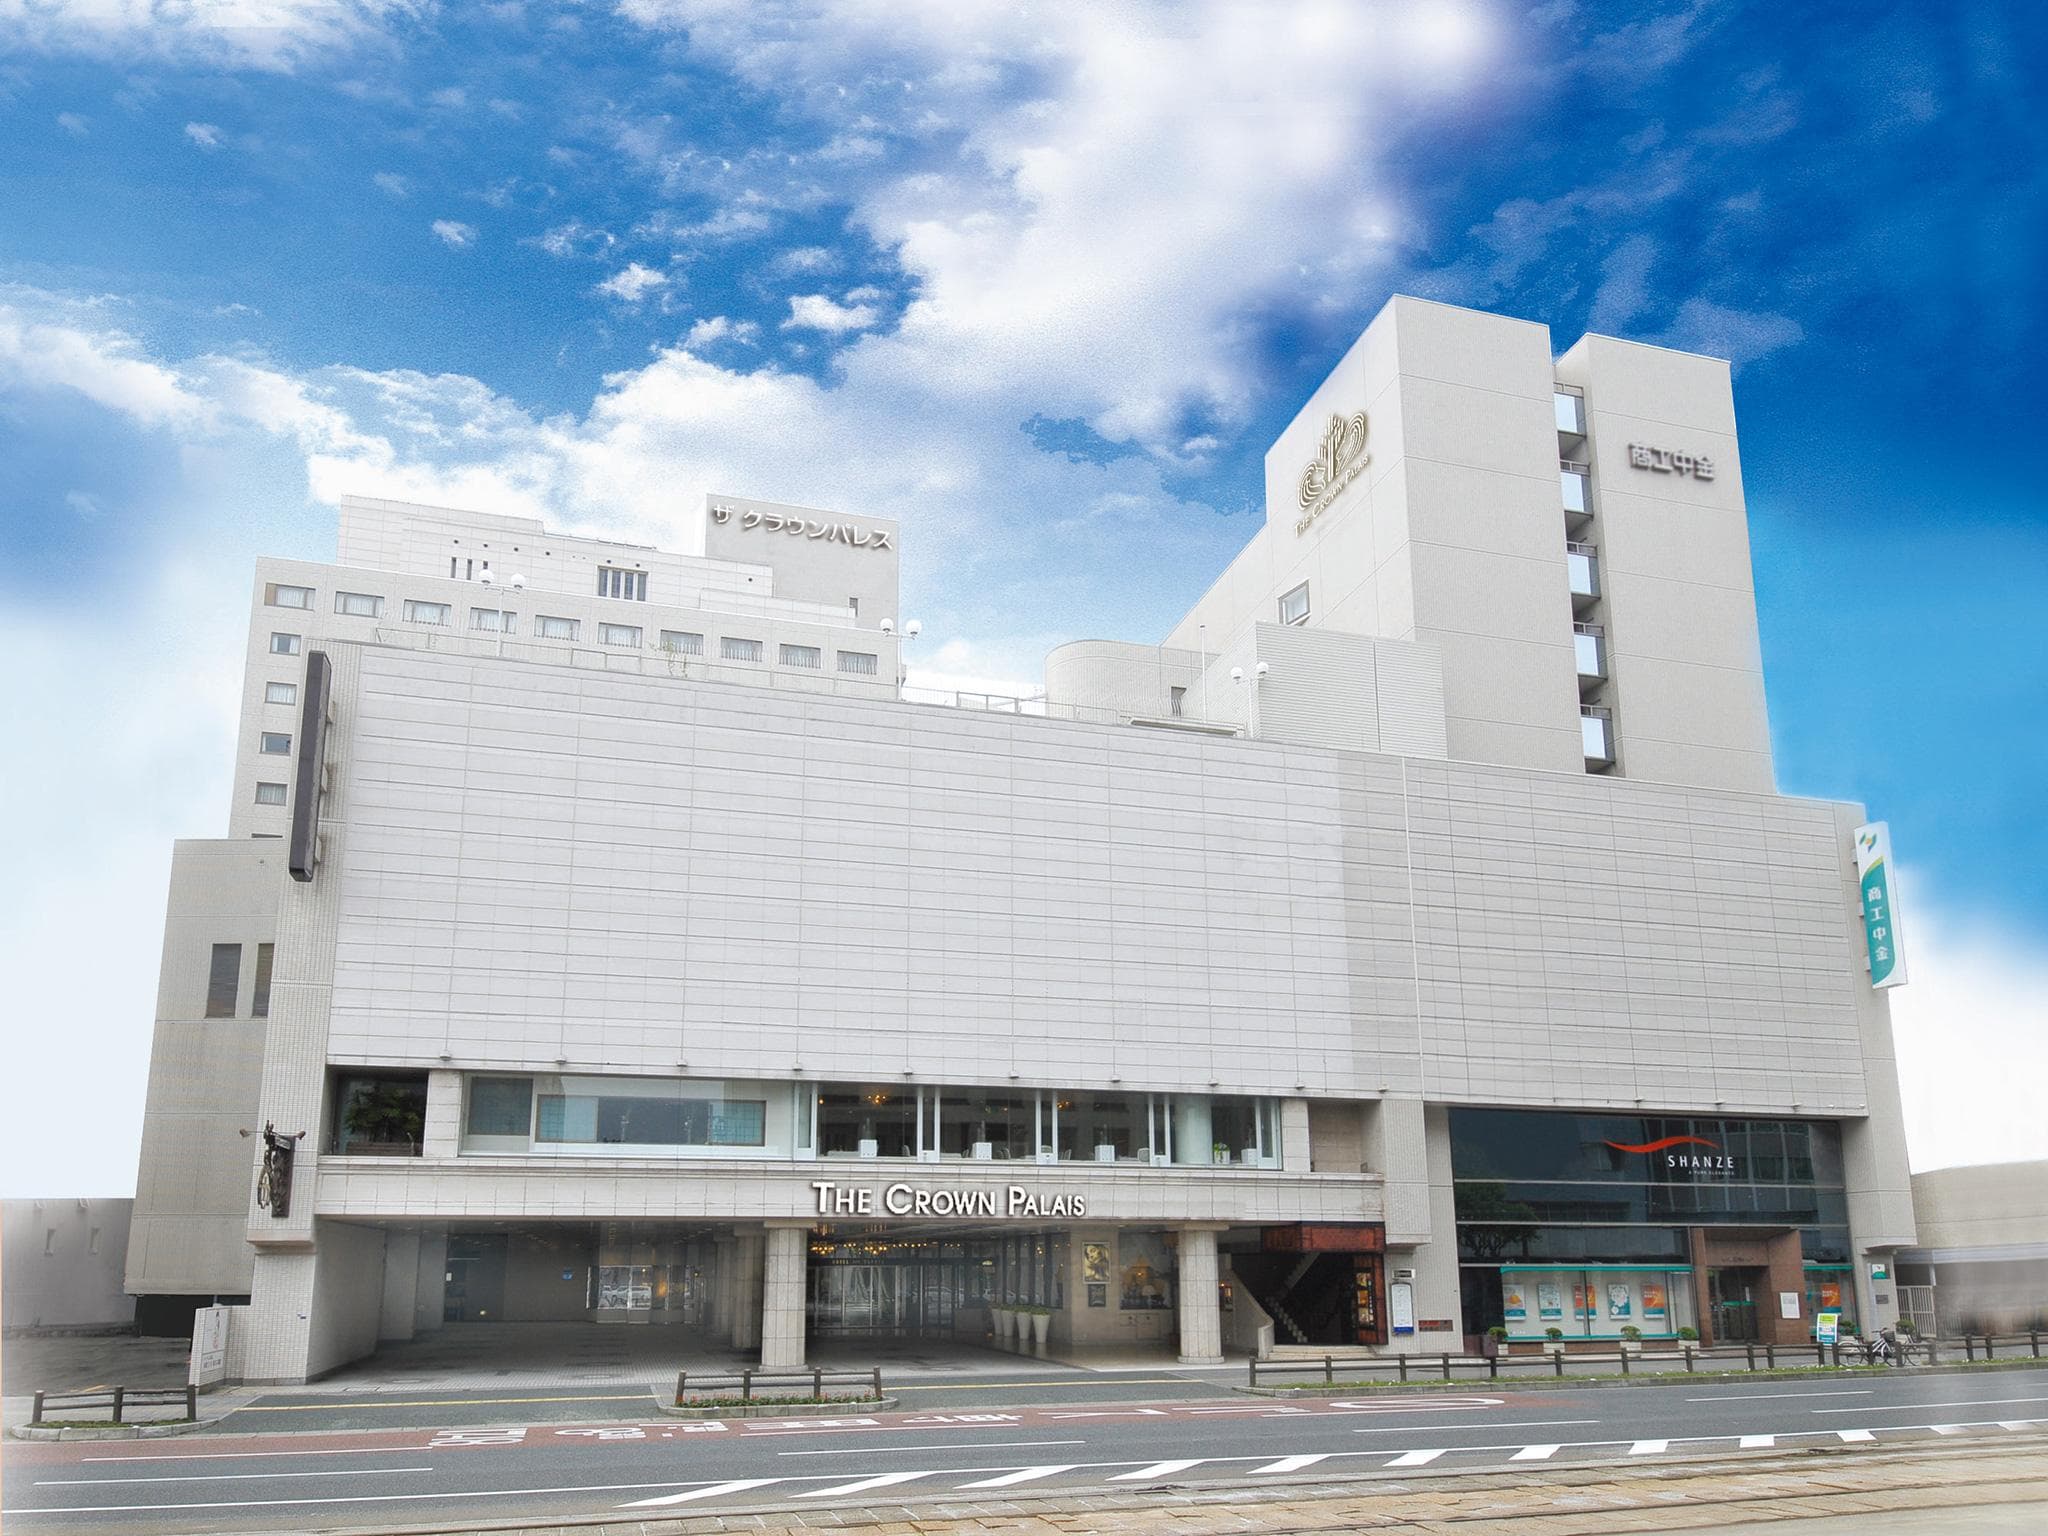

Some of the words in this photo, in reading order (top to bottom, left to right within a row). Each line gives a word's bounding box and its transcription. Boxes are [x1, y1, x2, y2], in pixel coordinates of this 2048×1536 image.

[1868, 887, 1888, 961] 商工中金
[1667, 1155, 1735, 1168] SHANZE
[812, 1181, 872, 1214] THE
[886, 1183, 996, 1216] CROWN
[1008, 1185, 1086, 1217] PALAIS
